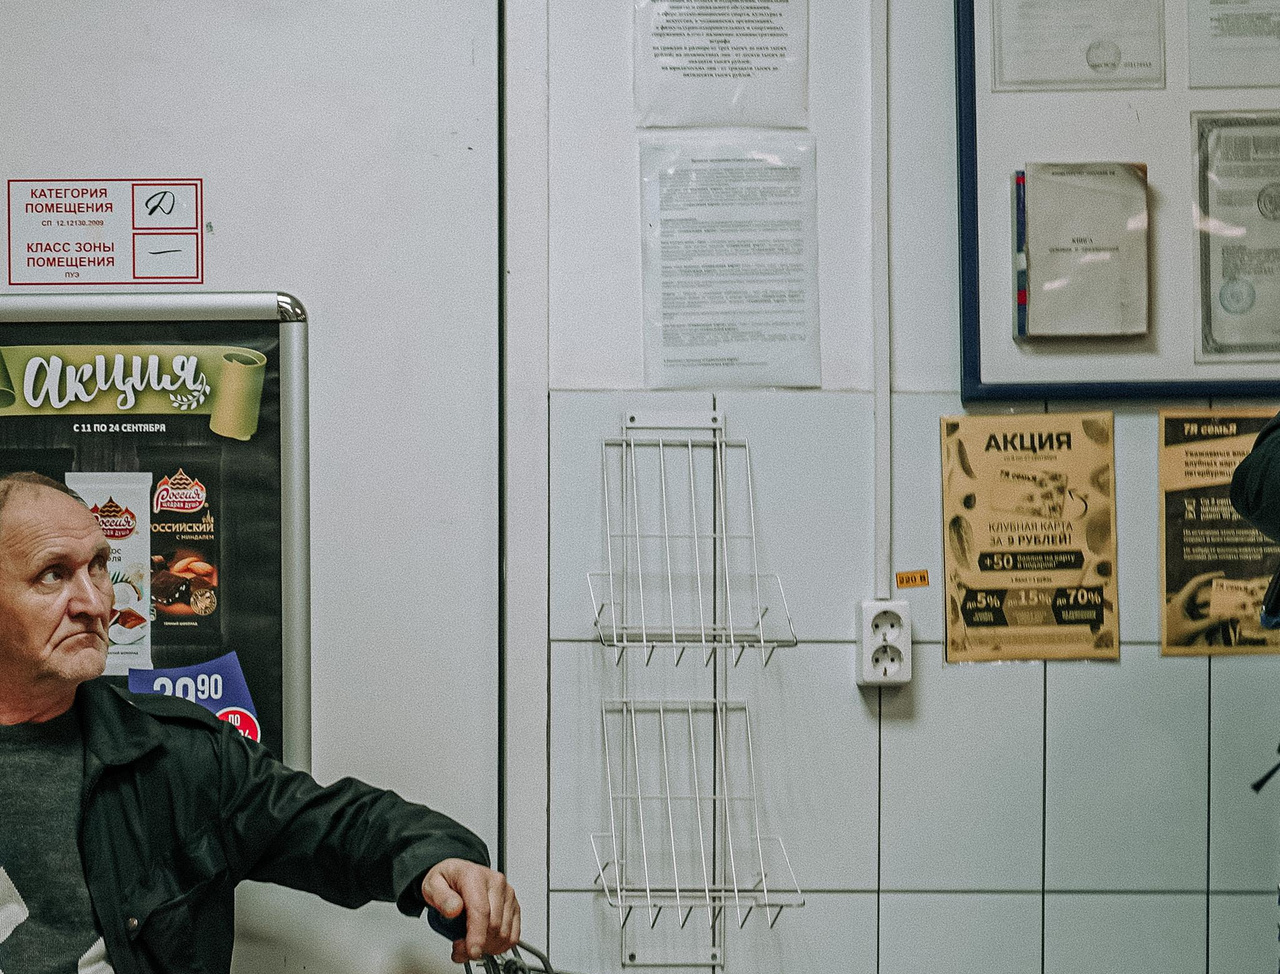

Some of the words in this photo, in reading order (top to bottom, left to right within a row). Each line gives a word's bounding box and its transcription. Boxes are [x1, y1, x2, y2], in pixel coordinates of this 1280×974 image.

[30, 188, 107, 199] КАТЕГОРИЯ
[25, 202, 113, 216] ПОМЕЩЕНИЯ
[26, 243, 71, 253] КЛАСС
[75, 242, 114, 252] ЗОНЫ
[27, 257, 115, 268] ПОМЕЩЕНИЯ
[73, 424, 80, 432] С
[81, 424, 91, 432] 11
[93, 424, 106, 432] ПО
[108, 424, 120, 432] 24
[122, 424, 166, 432] СЕНТЯБРЯ
[1201, 423, 1237, 436] семьЯ
[984, 432, 1072, 453] АКЦИЯ
[155, 487, 203, 512] Россия
[95, 510, 134, 528] оссия
[988, 522, 1037, 533] КЛУБНАЯ
[1040, 521, 1073, 532] КАРТА
[990, 536, 1003, 546] ЗА
[1018, 534, 1072, 546] РУБЛЕЙ!
[984, 554, 1013, 570] +50
[977, 592, 1000, 609] 5%
[1019, 589, 1052, 605] 15%
[1066, 589, 1101, 605] 70%
[197, 673, 222, 700] 90
